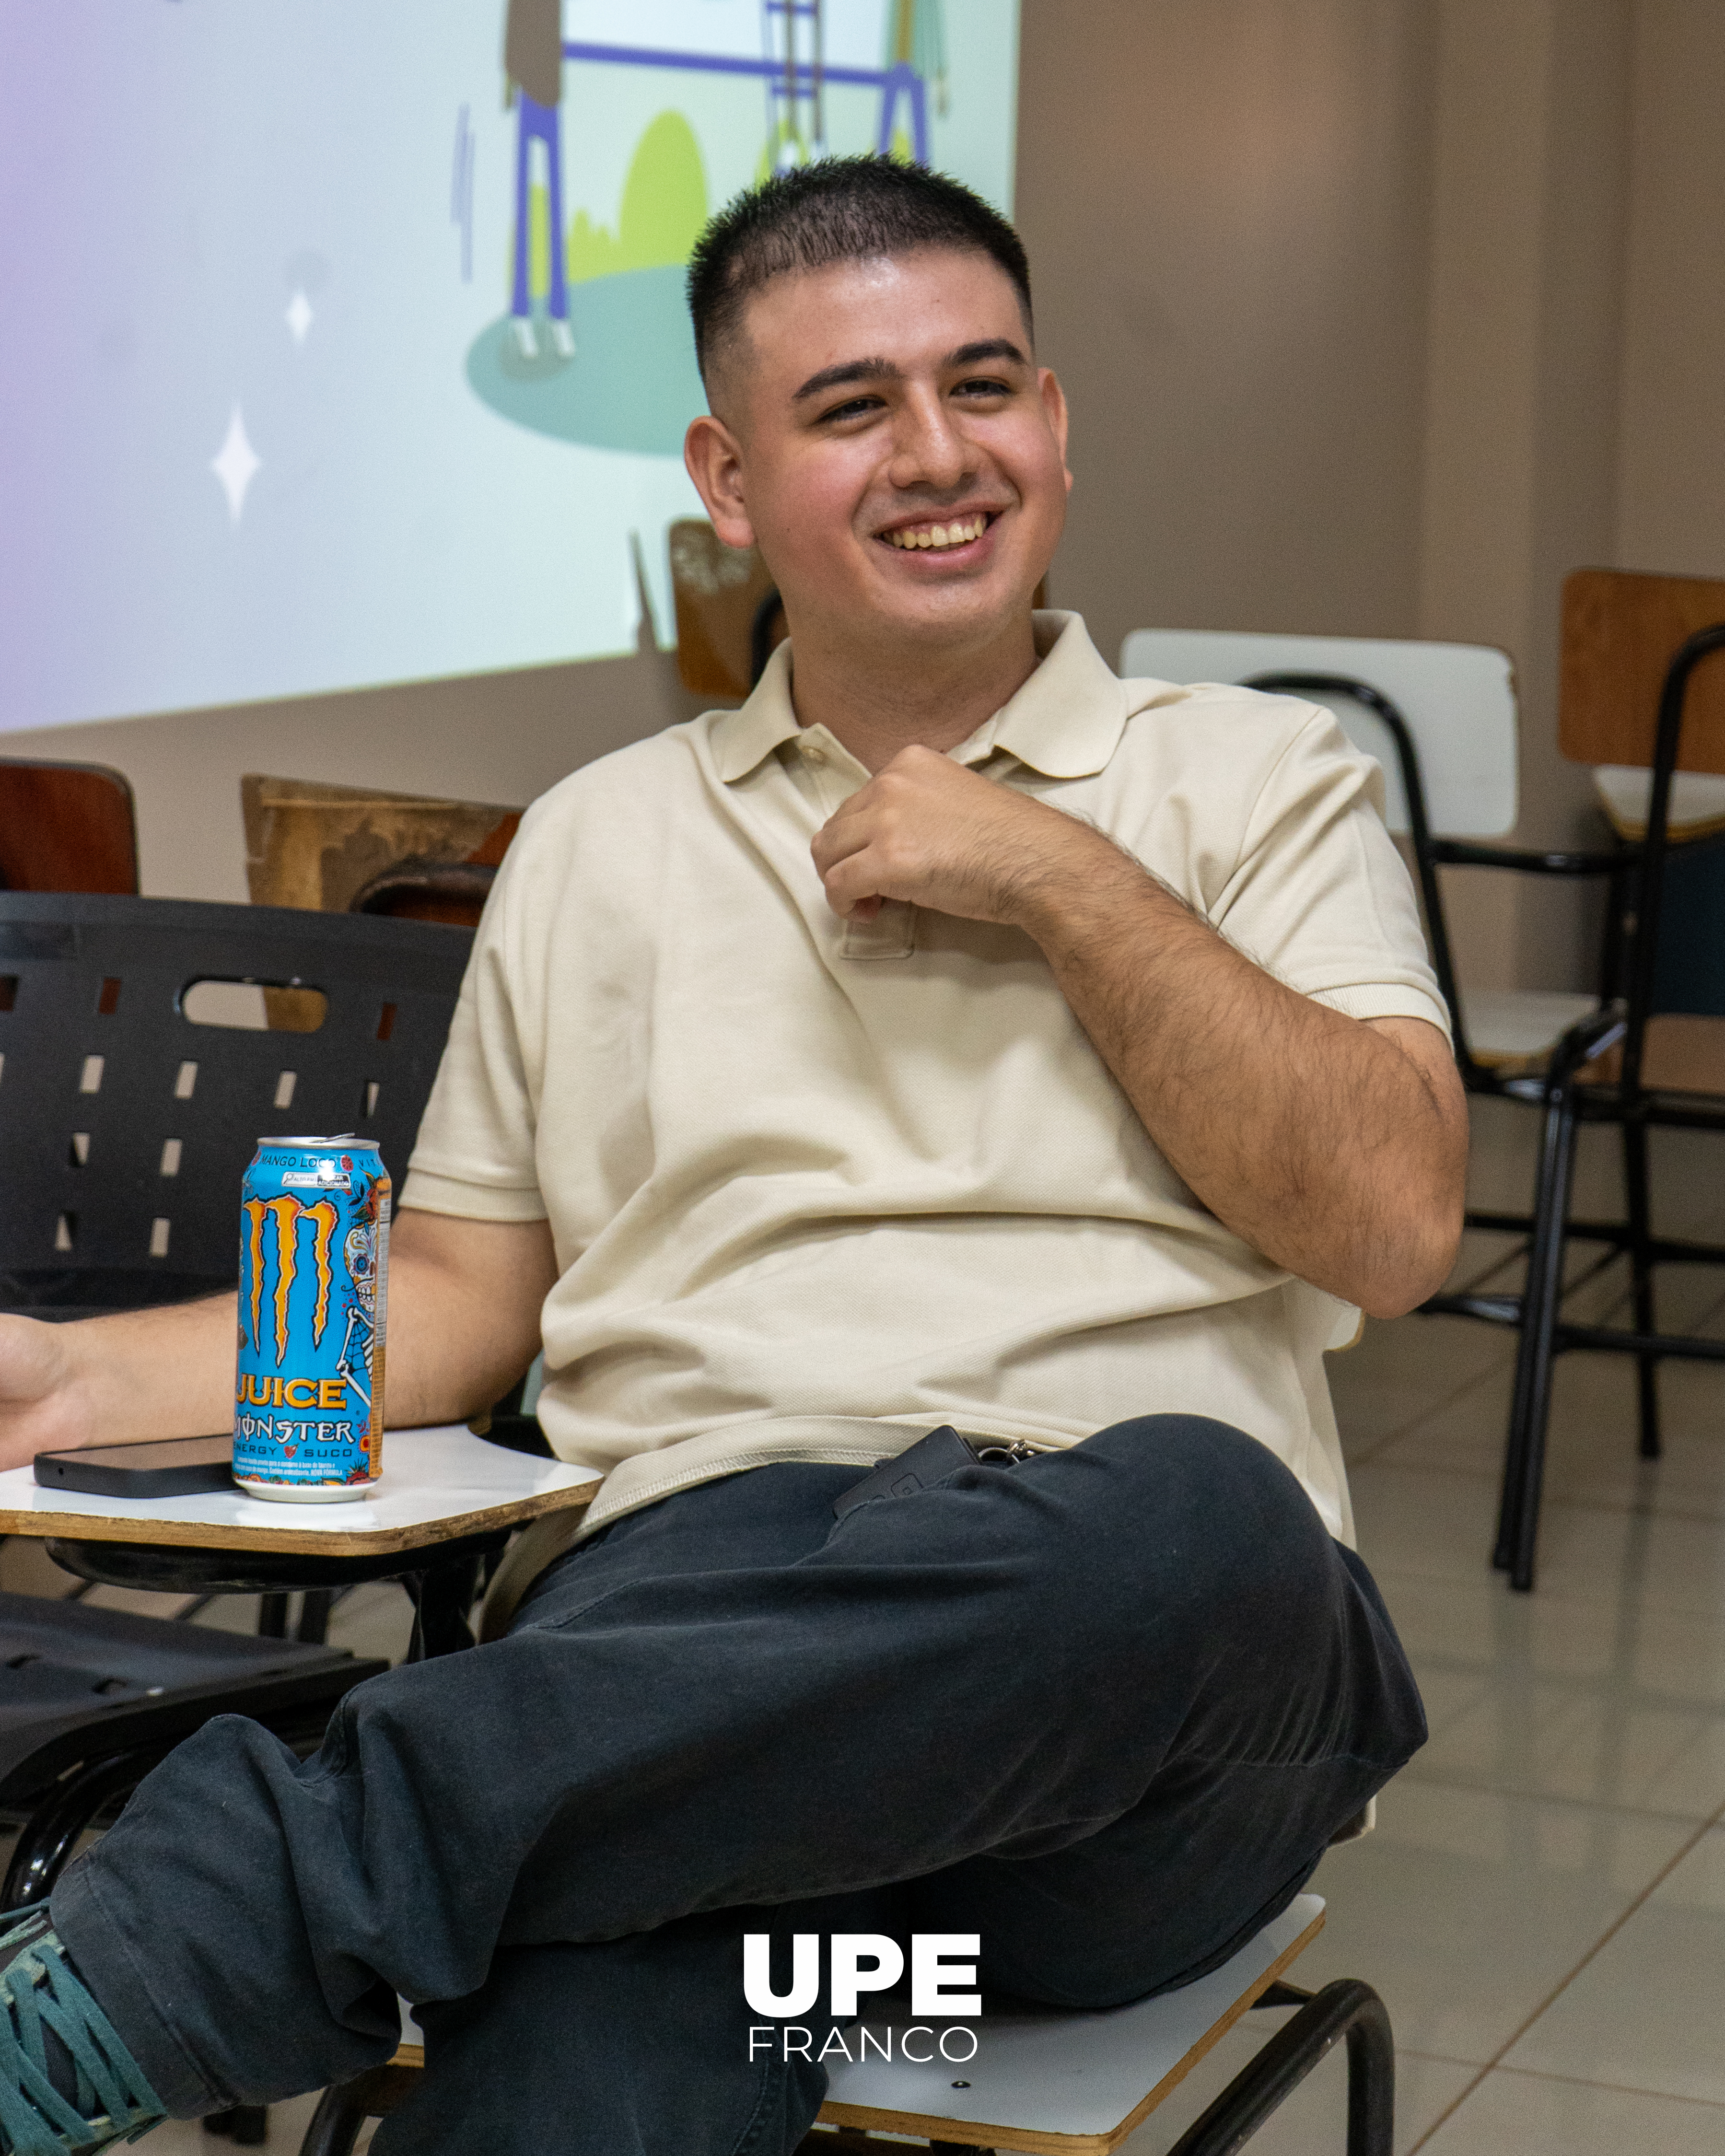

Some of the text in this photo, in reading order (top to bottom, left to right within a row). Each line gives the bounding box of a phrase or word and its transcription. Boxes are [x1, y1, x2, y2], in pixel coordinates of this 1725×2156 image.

[261, 1155, 296, 1166] MANGO
[236, 1373, 347, 1410] JUICE
[233, 1441, 352, 1457] ENERGY SUCO
